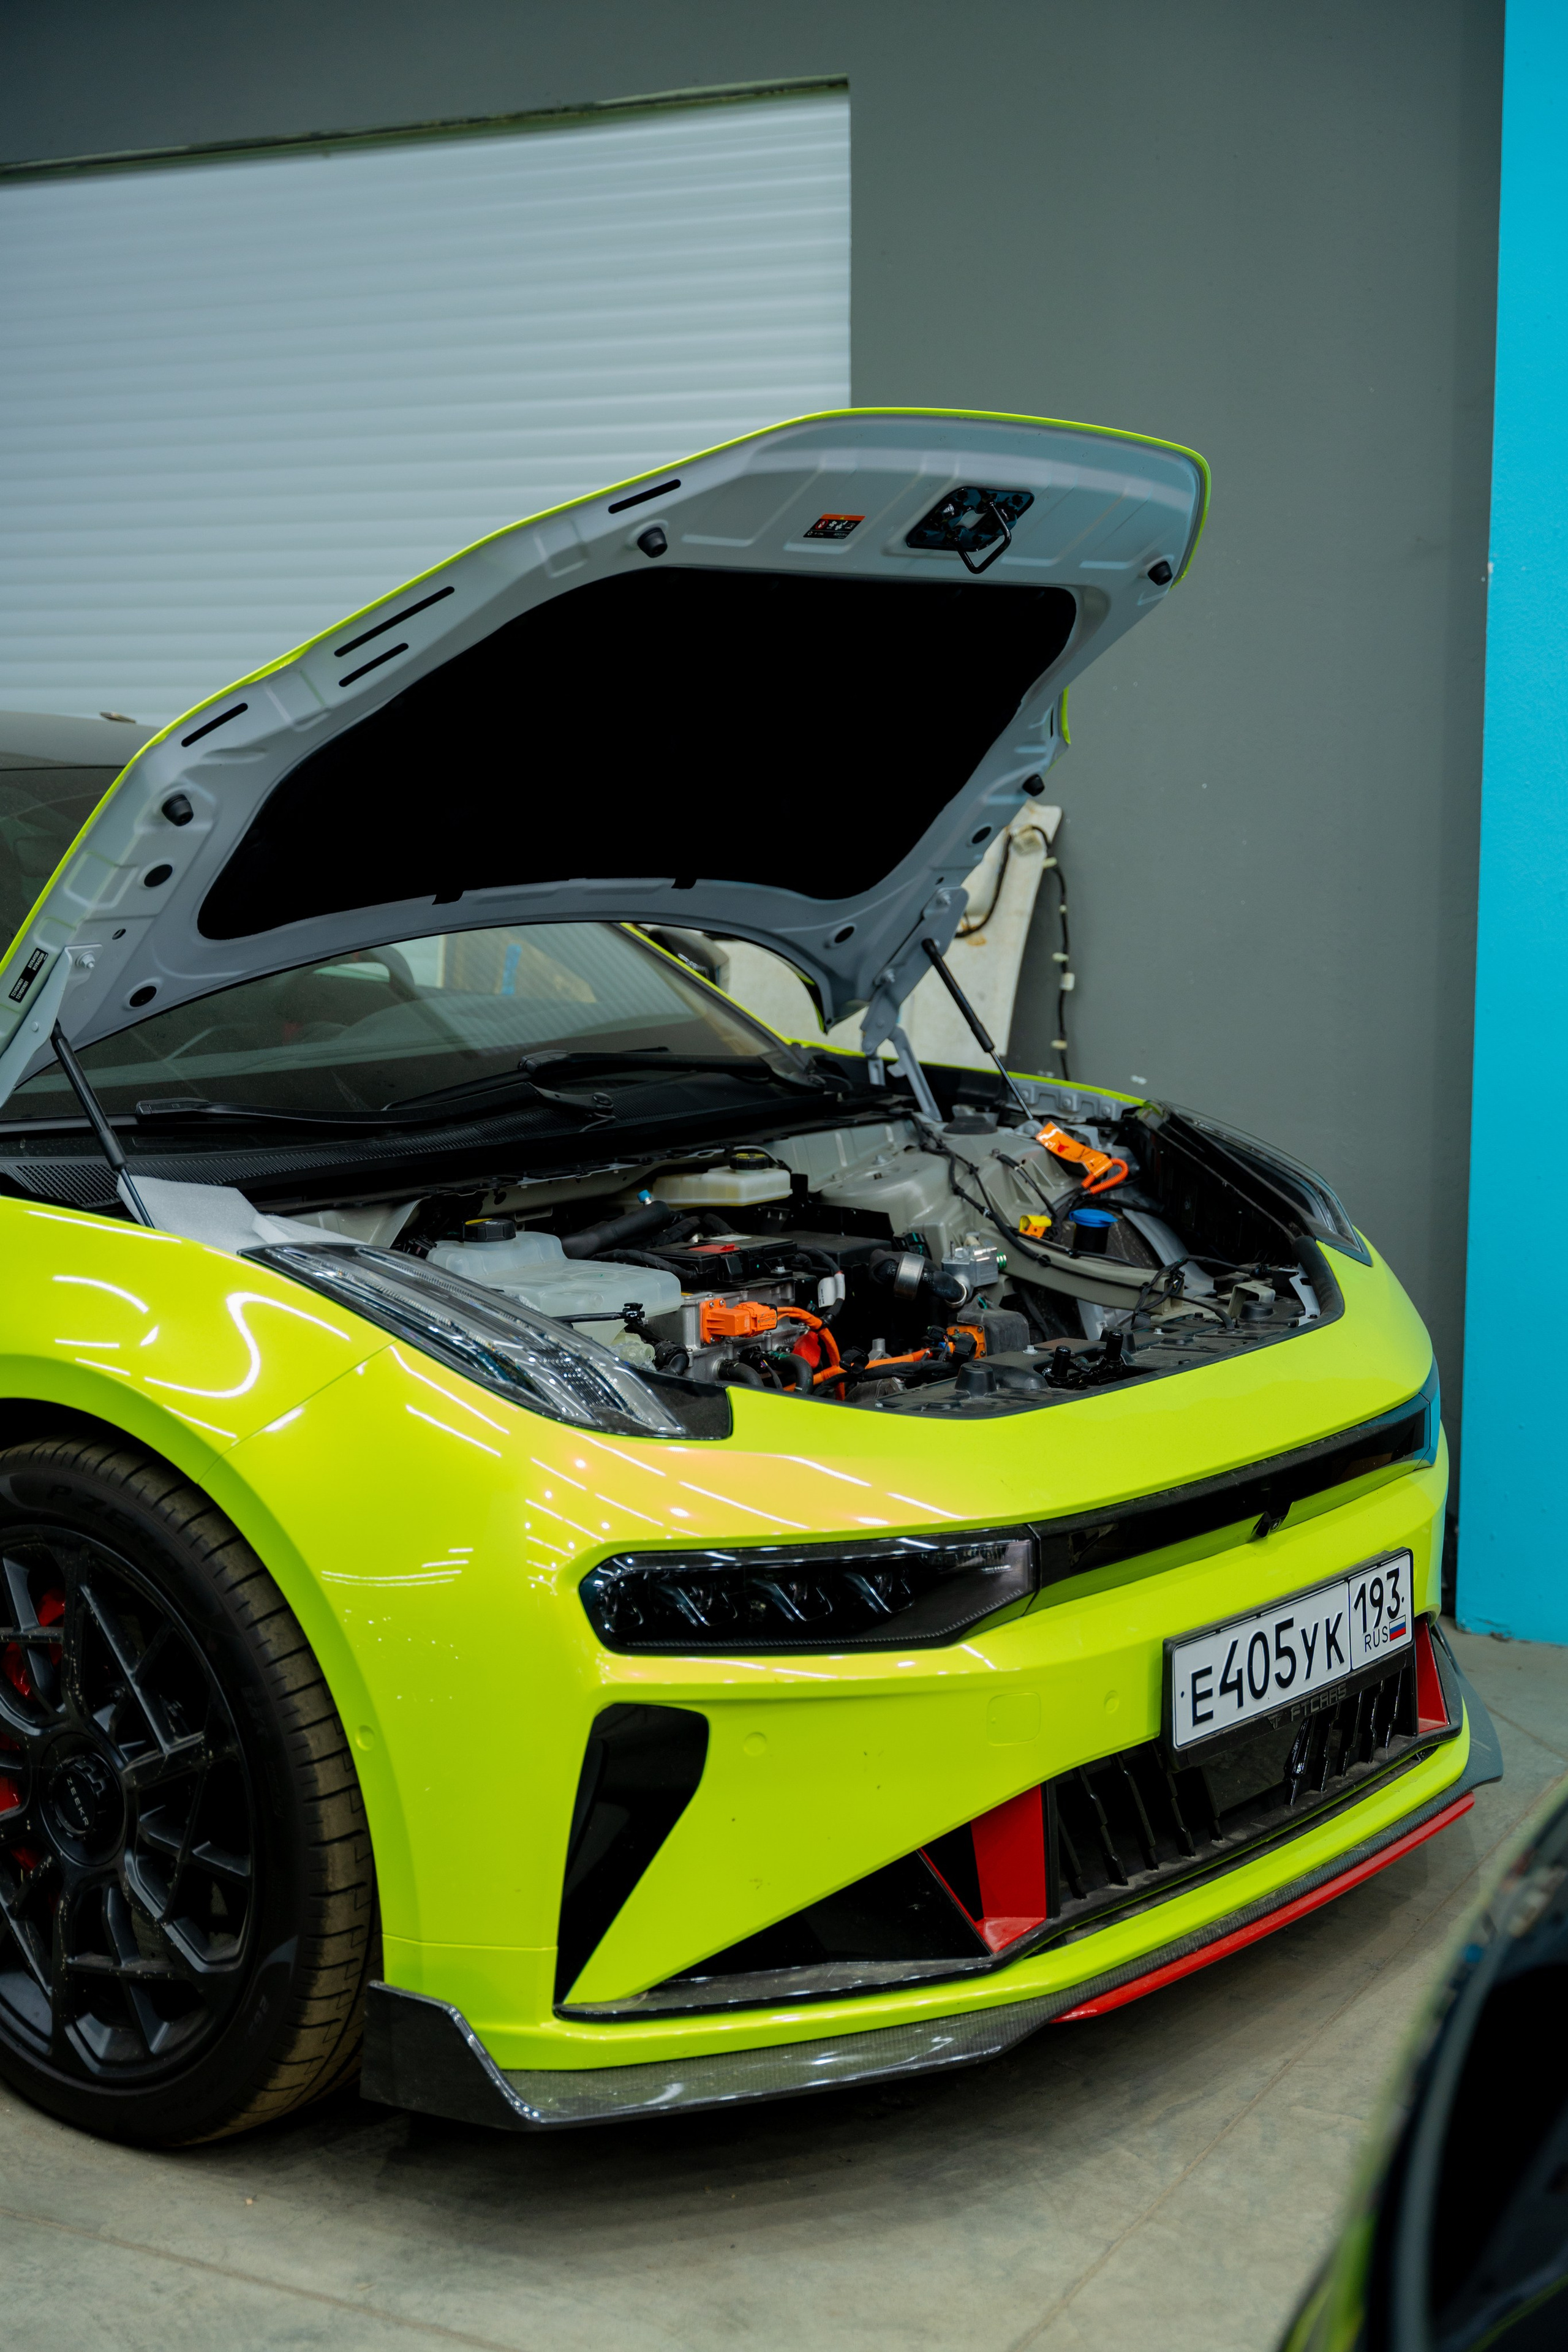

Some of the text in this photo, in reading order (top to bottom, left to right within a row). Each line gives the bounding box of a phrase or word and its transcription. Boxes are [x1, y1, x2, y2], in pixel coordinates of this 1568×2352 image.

[77, 1494, 184, 1575] ZERO
[1353, 1567, 1400, 1634] 193
[1364, 1626, 1389, 1653] RUS
[1291, 1683, 1347, 1722] FTCARS
[66, 1776, 89, 1826] ZEEKR
